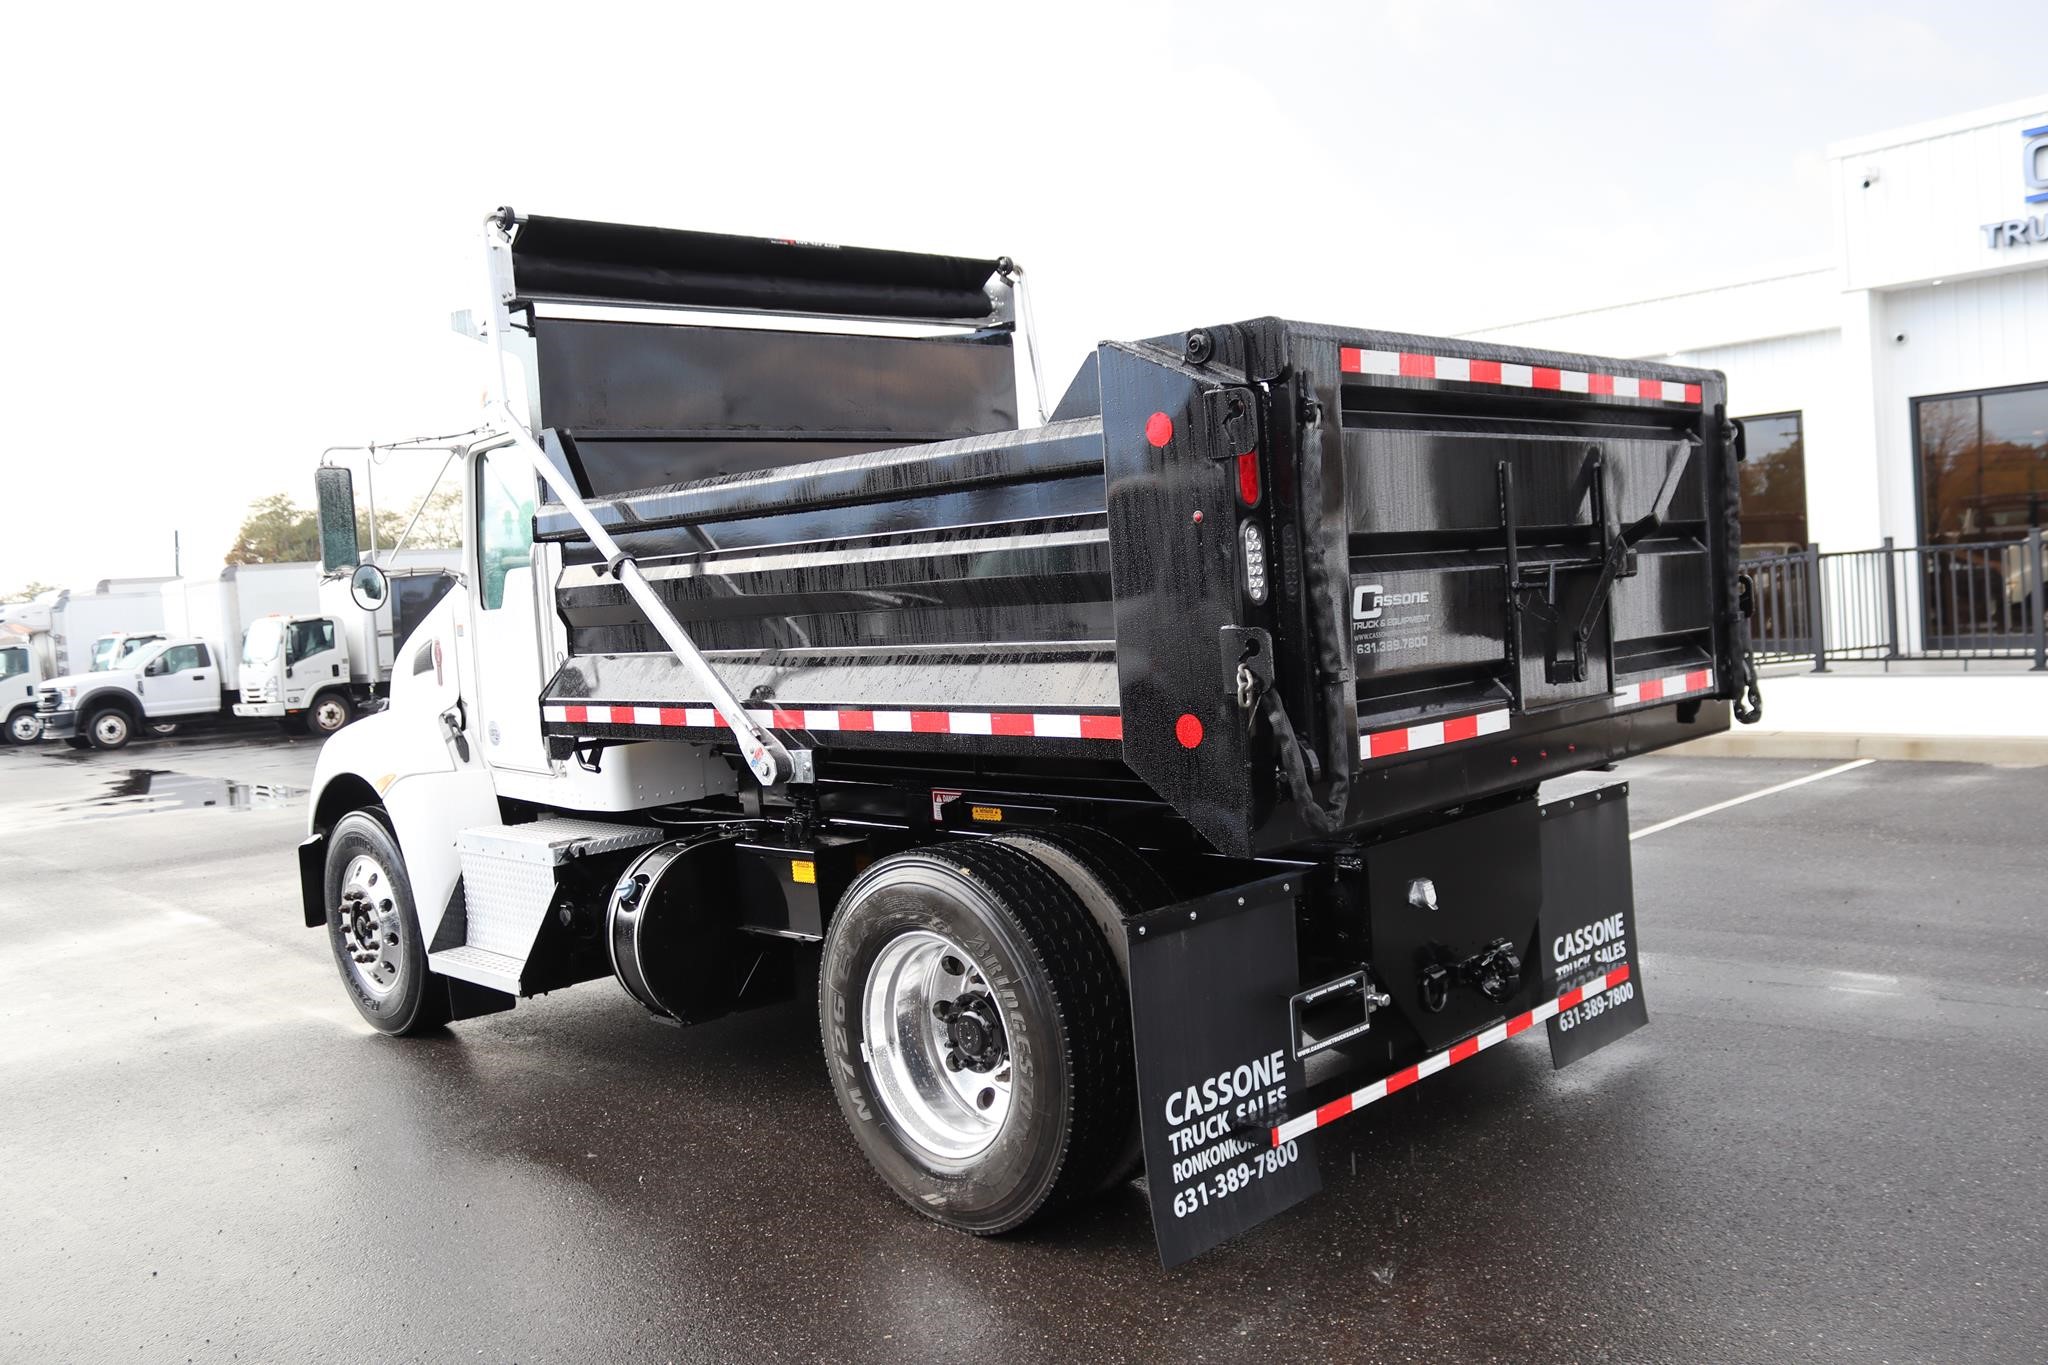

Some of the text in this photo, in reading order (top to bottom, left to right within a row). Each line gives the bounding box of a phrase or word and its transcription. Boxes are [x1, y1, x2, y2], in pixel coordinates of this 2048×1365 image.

[1353, 584, 1430, 620] CASSONE
[1353, 620, 1379, 631] TRUCK
[1553, 912, 1625, 963] CASSONE
[1594, 940, 1627, 963] SALES
[1559, 981, 1634, 1032] 631-389-7800
[1165, 1049, 1286, 1126] CASSONE
[1168, 1110, 1231, 1156] TRUCK
[1173, 1139, 1298, 1218] 631-389-7800
